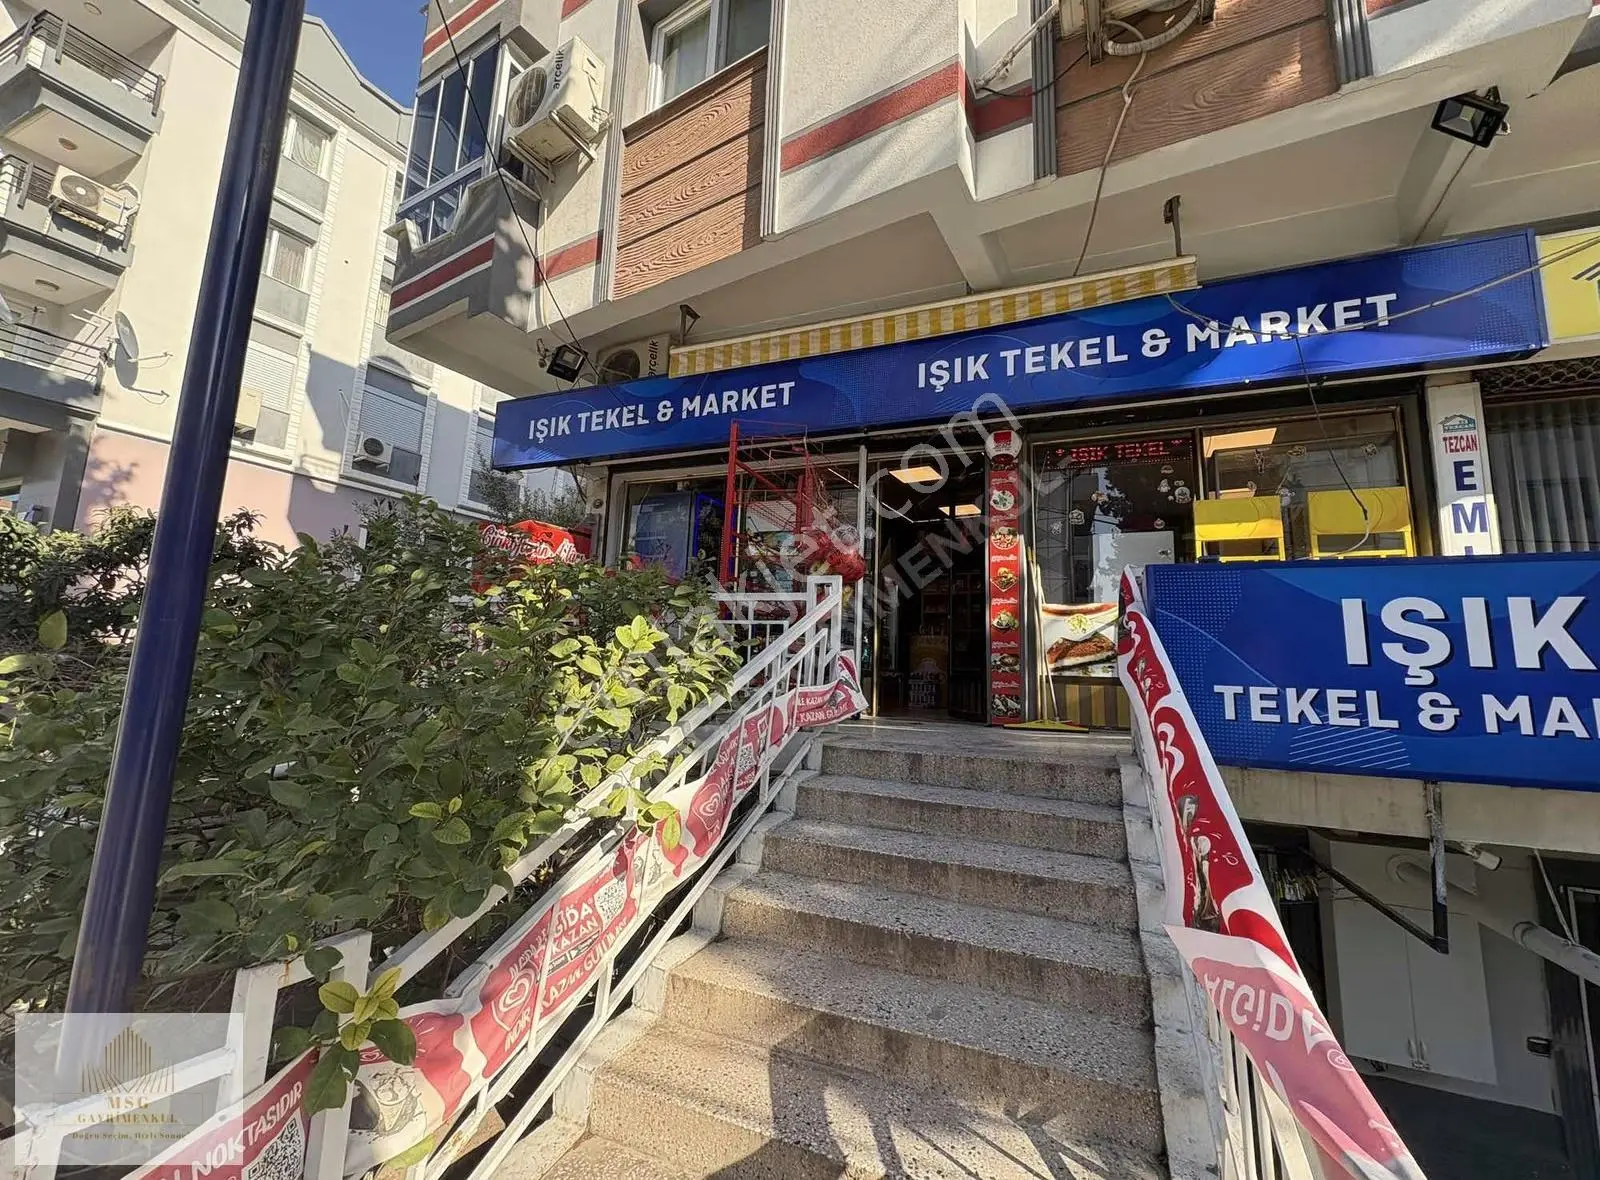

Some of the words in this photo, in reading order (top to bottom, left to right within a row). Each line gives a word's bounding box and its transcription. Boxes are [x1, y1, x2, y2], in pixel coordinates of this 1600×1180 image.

[917, 354, 989, 393] IŞIK
[1000, 336, 1129, 377] TEKEL
[1141, 328, 1171, 358] &
[1187, 293, 1397, 353] MARKET
[528, 415, 570, 444] IŞIK
[577, 404, 650, 433] TEKEL
[656, 400, 674, 423] &
[682, 381, 796, 420] MARKET
[1442, 434, 1478, 454] TEZCAN
[1341, 596, 1599, 685] IŞIK
[1213, 685, 1399, 729] TEKEL
[1417, 691, 1460, 732] &
